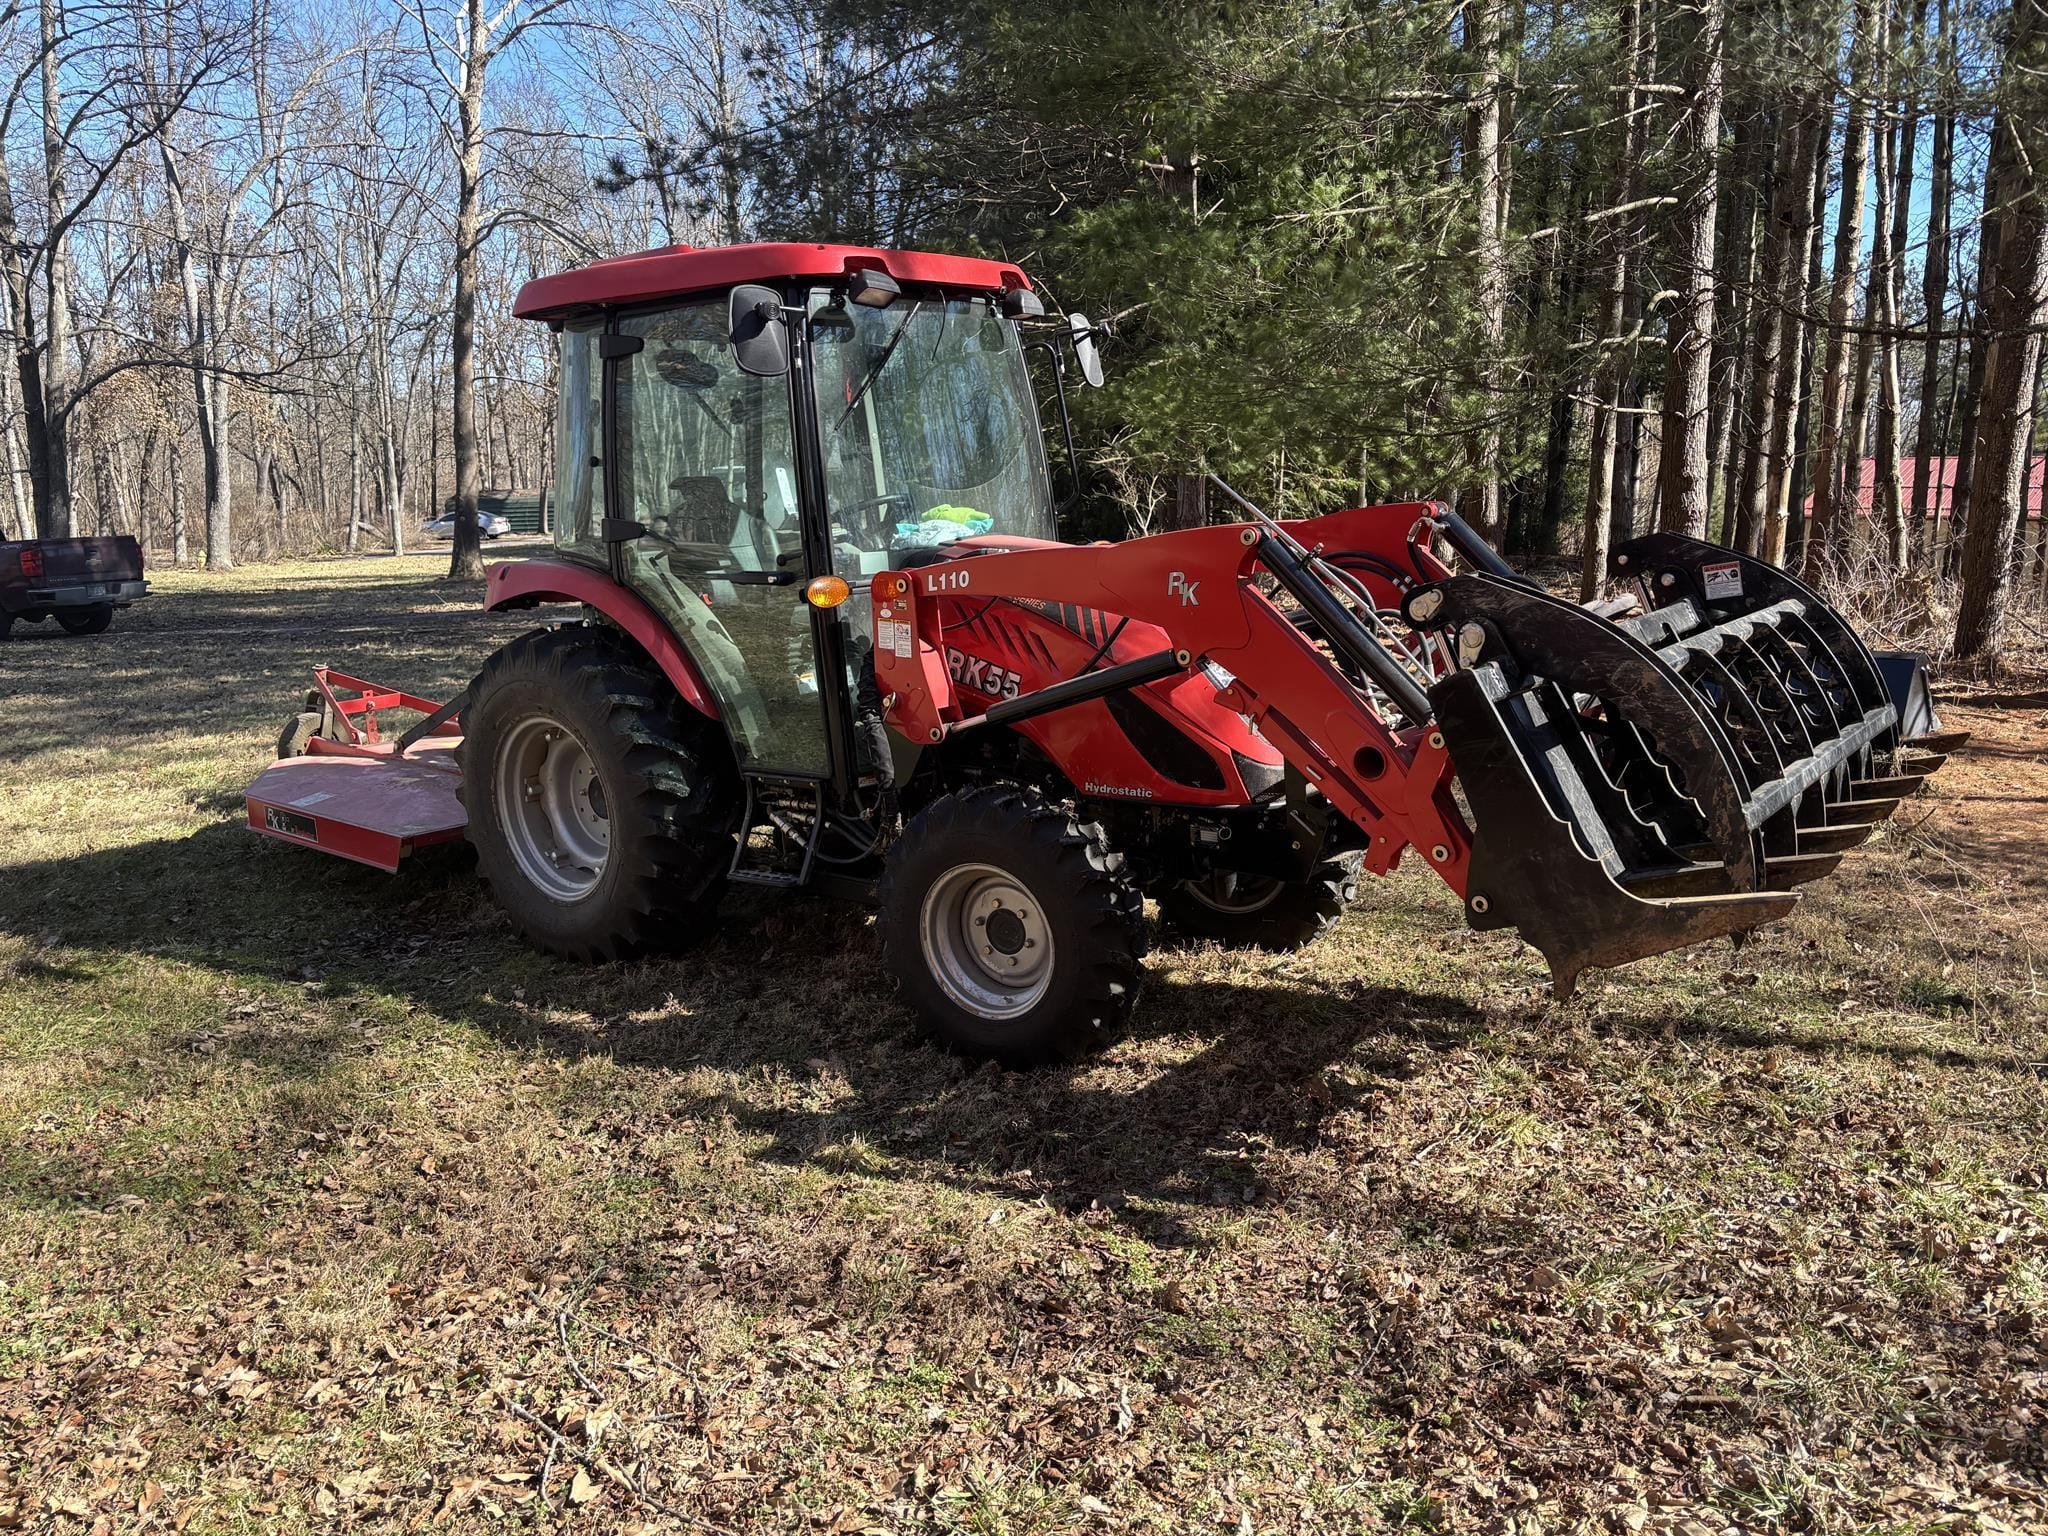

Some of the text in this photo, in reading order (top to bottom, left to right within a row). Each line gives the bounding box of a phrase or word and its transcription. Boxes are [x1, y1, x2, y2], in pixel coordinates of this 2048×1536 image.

[928, 570, 970, 592] L110
[1168, 572, 1200, 606] RK
[947, 647, 1022, 700] RK55
[1084, 782, 1153, 798] Hydrostatic
